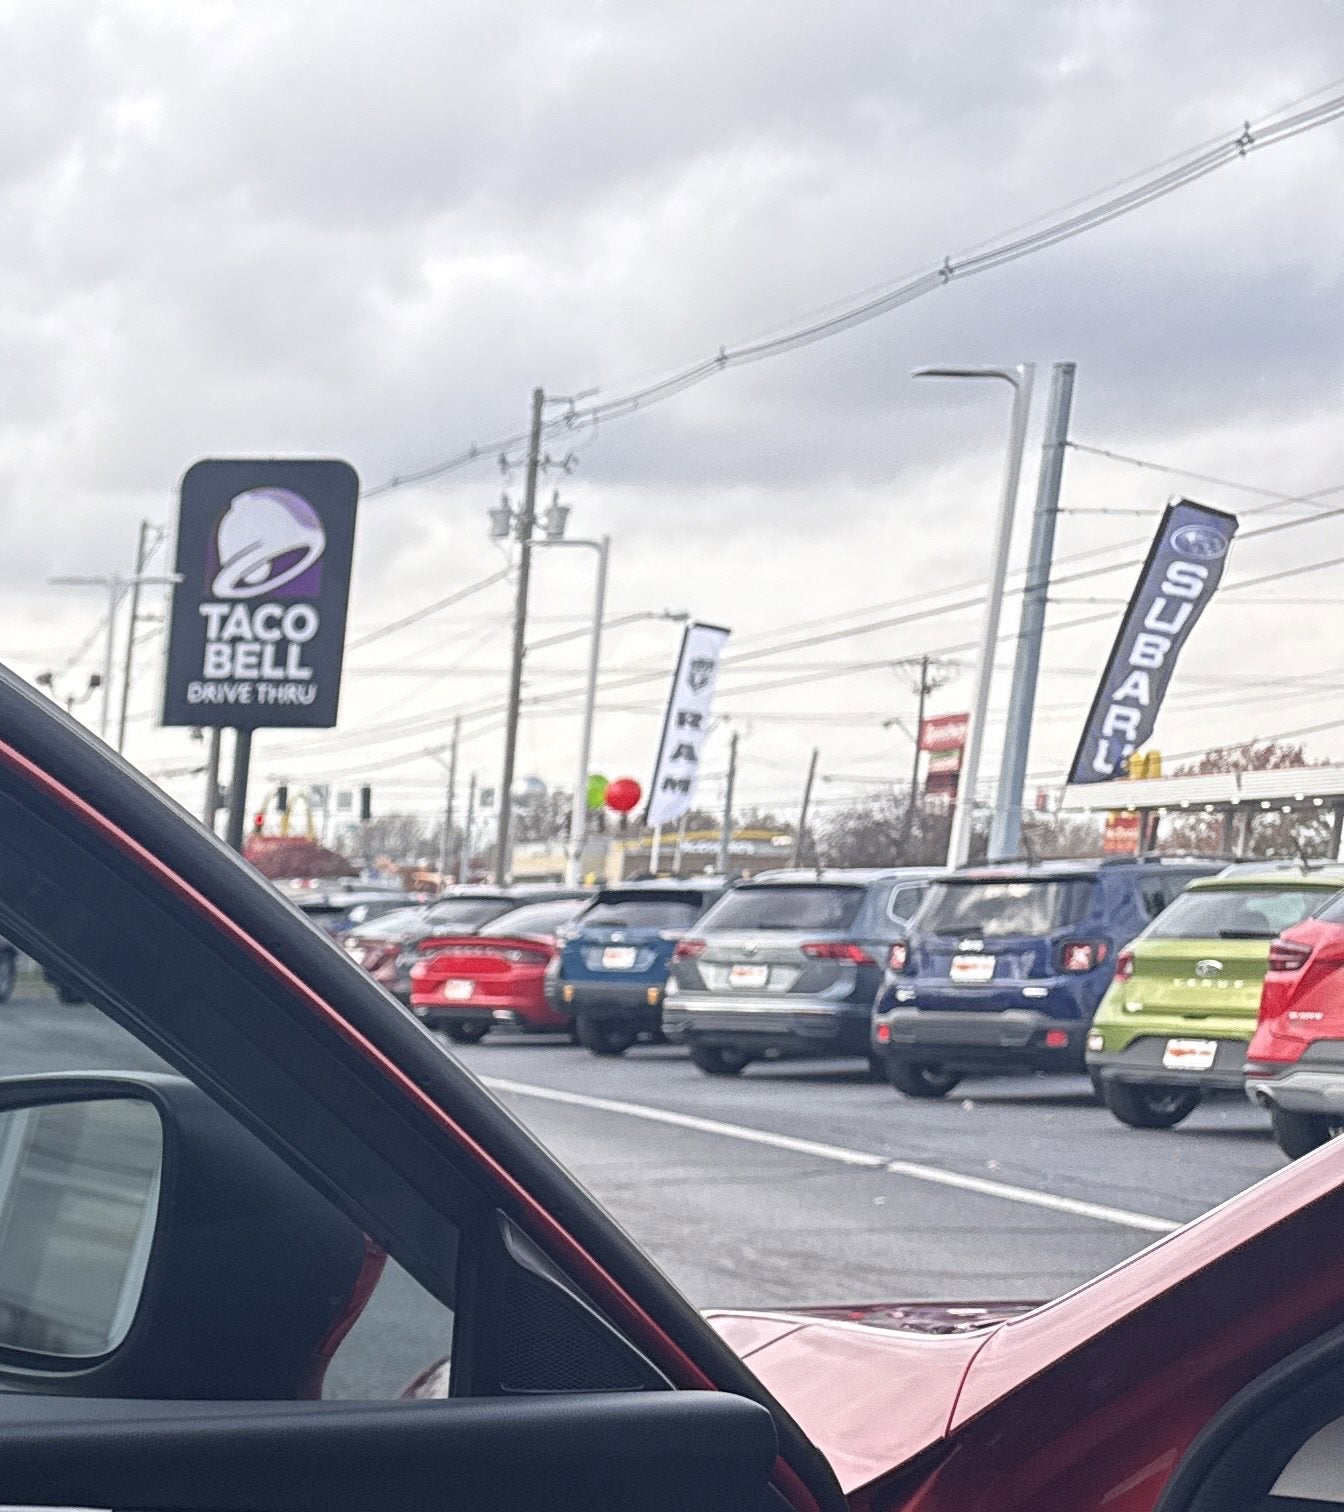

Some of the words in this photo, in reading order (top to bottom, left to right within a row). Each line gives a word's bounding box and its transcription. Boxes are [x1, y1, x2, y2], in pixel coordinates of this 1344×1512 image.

[198, 602, 320, 643] TACO
[203, 641, 313, 680] BELL
[1093, 561, 1208, 775] SUBARU
[187, 681, 253, 704] DRIVE
[256, 681, 318, 705] THRU
[662, 711, 703, 793] RAM
